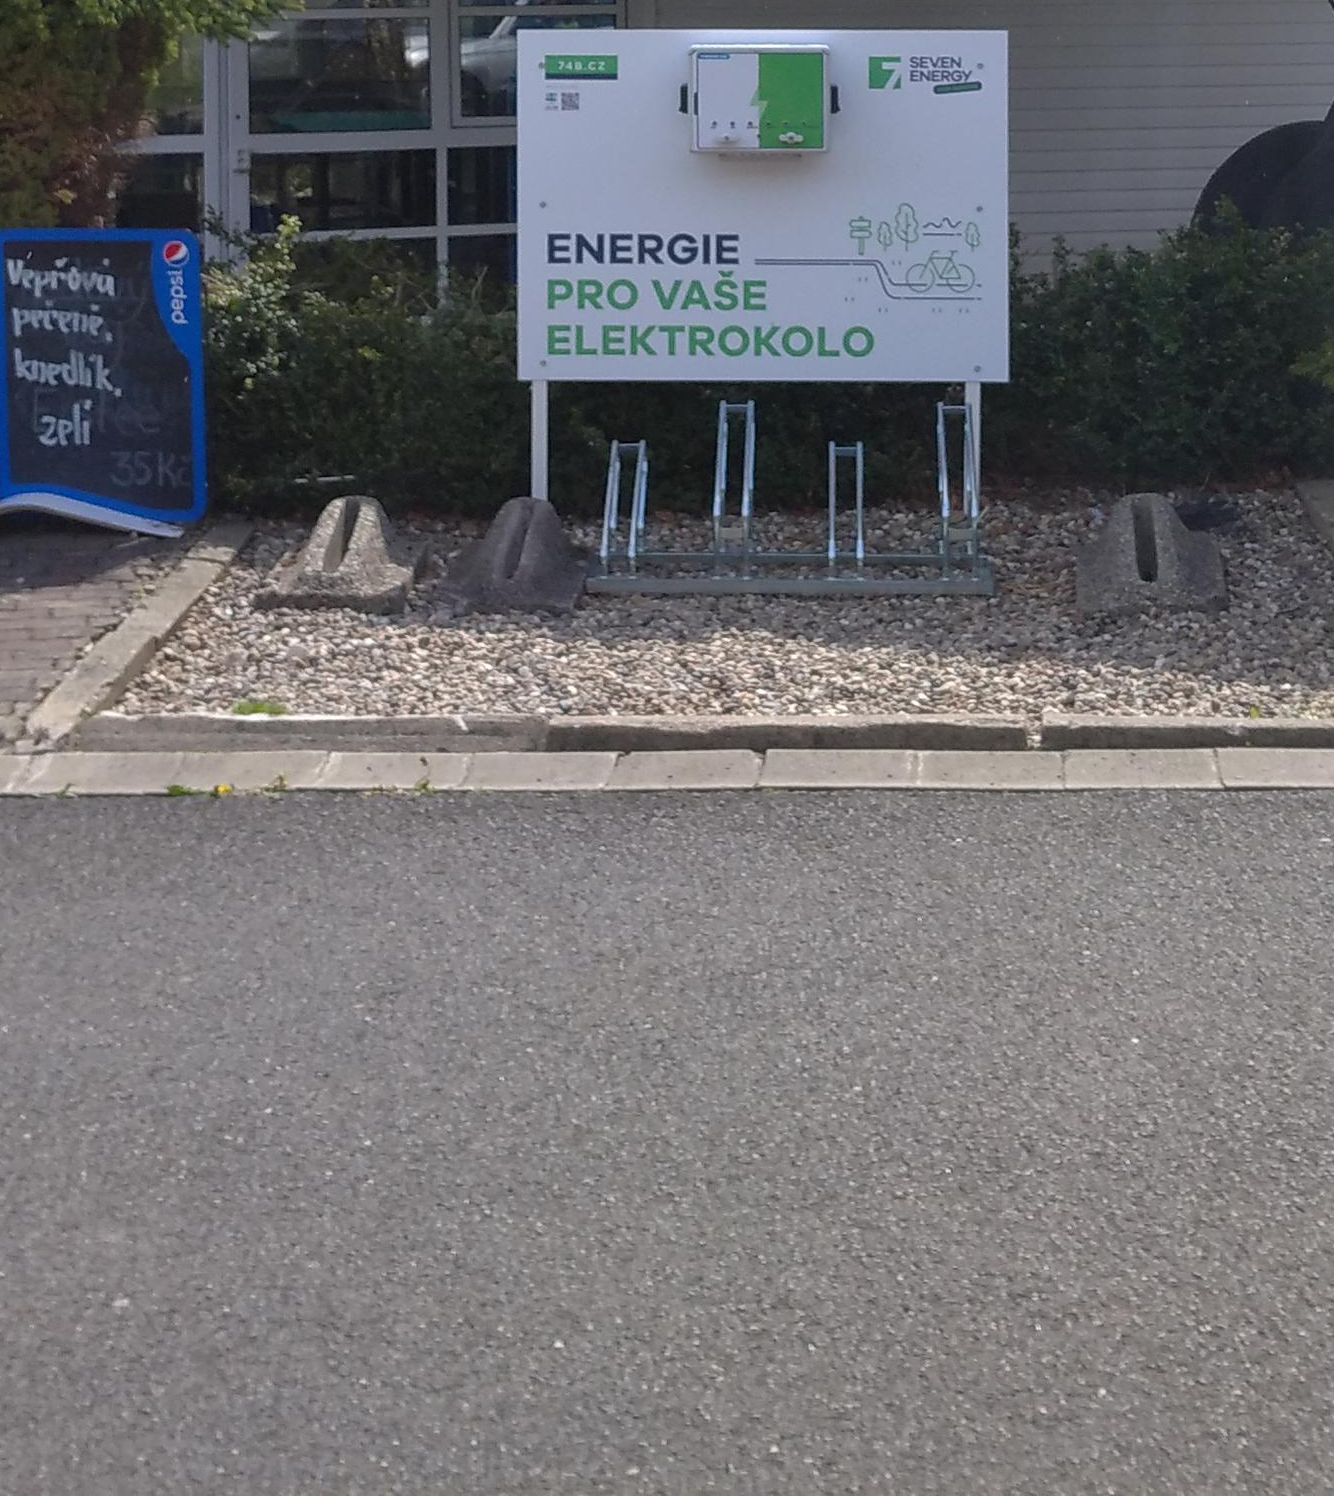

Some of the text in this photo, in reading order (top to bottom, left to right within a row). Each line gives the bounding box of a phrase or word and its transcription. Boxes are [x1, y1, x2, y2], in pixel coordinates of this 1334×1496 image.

[557, 61, 605, 71] 74B.CZ
[909, 56, 962, 69] SEVEN
[909, 70, 973, 82] ENERGY
[547, 233, 740, 265] ENERGIE
[166, 267, 189, 325] pepsi
[547, 270, 767, 311] PRO VAŠE
[547, 325, 875, 357] ELEKTROKOLO
